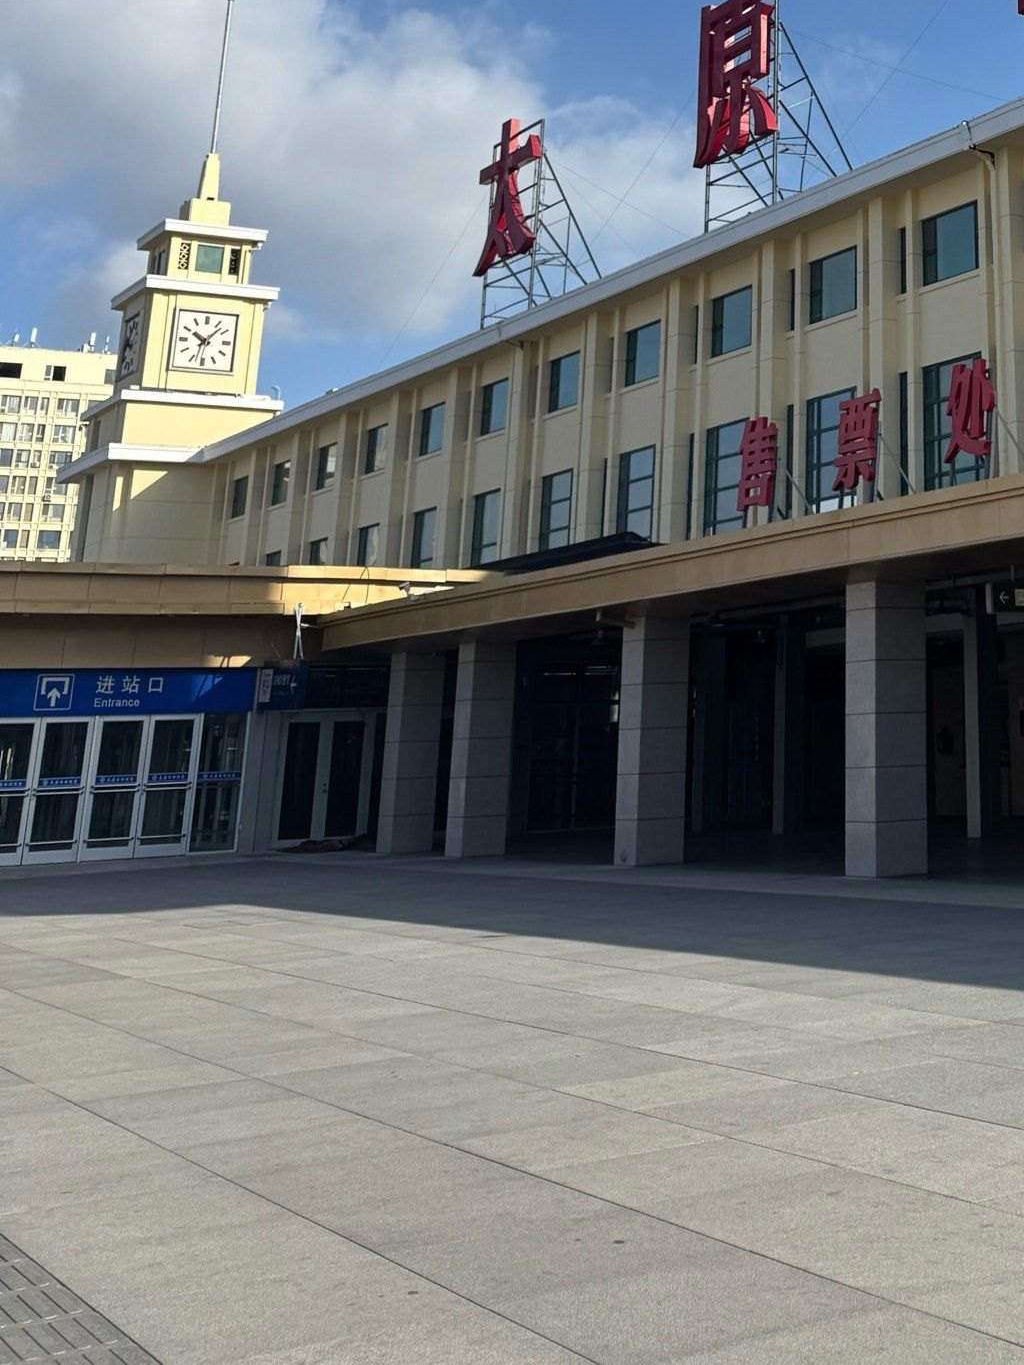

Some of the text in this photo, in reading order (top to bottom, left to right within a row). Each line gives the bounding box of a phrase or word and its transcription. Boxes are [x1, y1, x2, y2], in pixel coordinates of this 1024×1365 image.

[737, 358, 995, 511] 售票处
[95, 675, 164, 694] 进站口
[93, 697, 141, 708] Entrance
